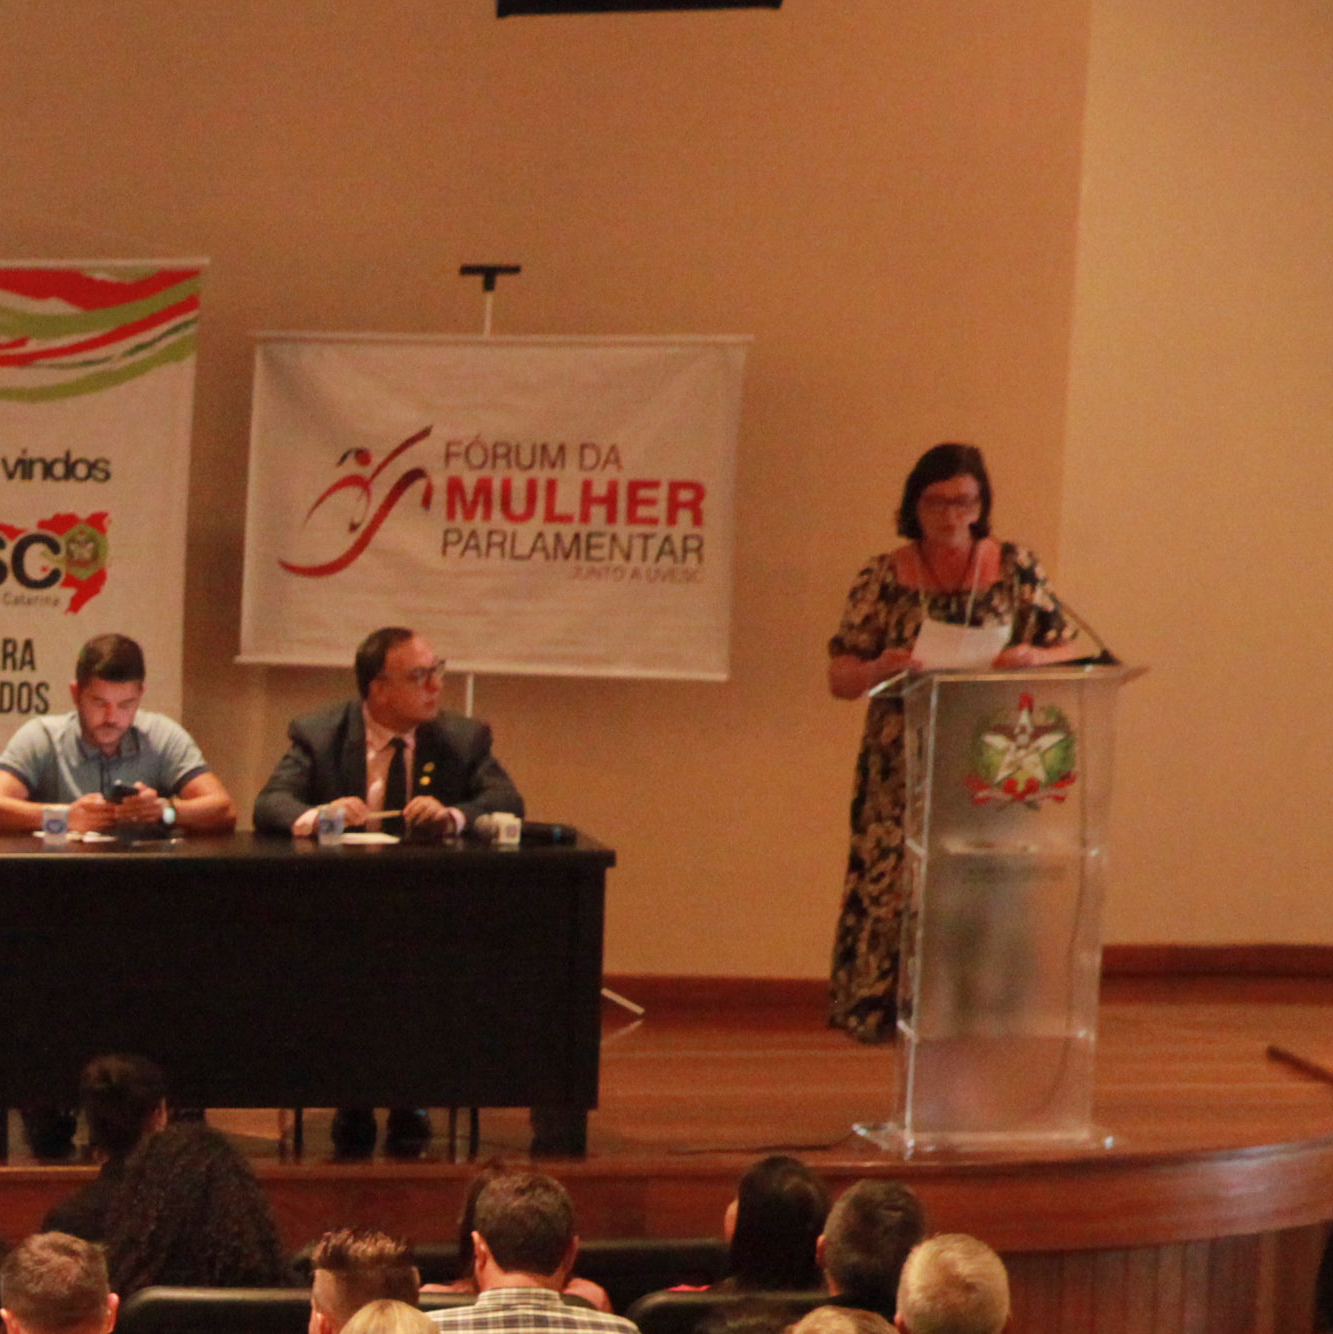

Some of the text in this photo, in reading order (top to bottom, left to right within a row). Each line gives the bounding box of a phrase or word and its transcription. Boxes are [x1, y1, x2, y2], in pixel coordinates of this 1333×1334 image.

[1, 450, 112, 483] vindos
[443, 434, 624, 472] FÓRUM DA
[445, 476, 707, 527] MULHER
[441, 527, 705, 565] PARLAMENTAR
